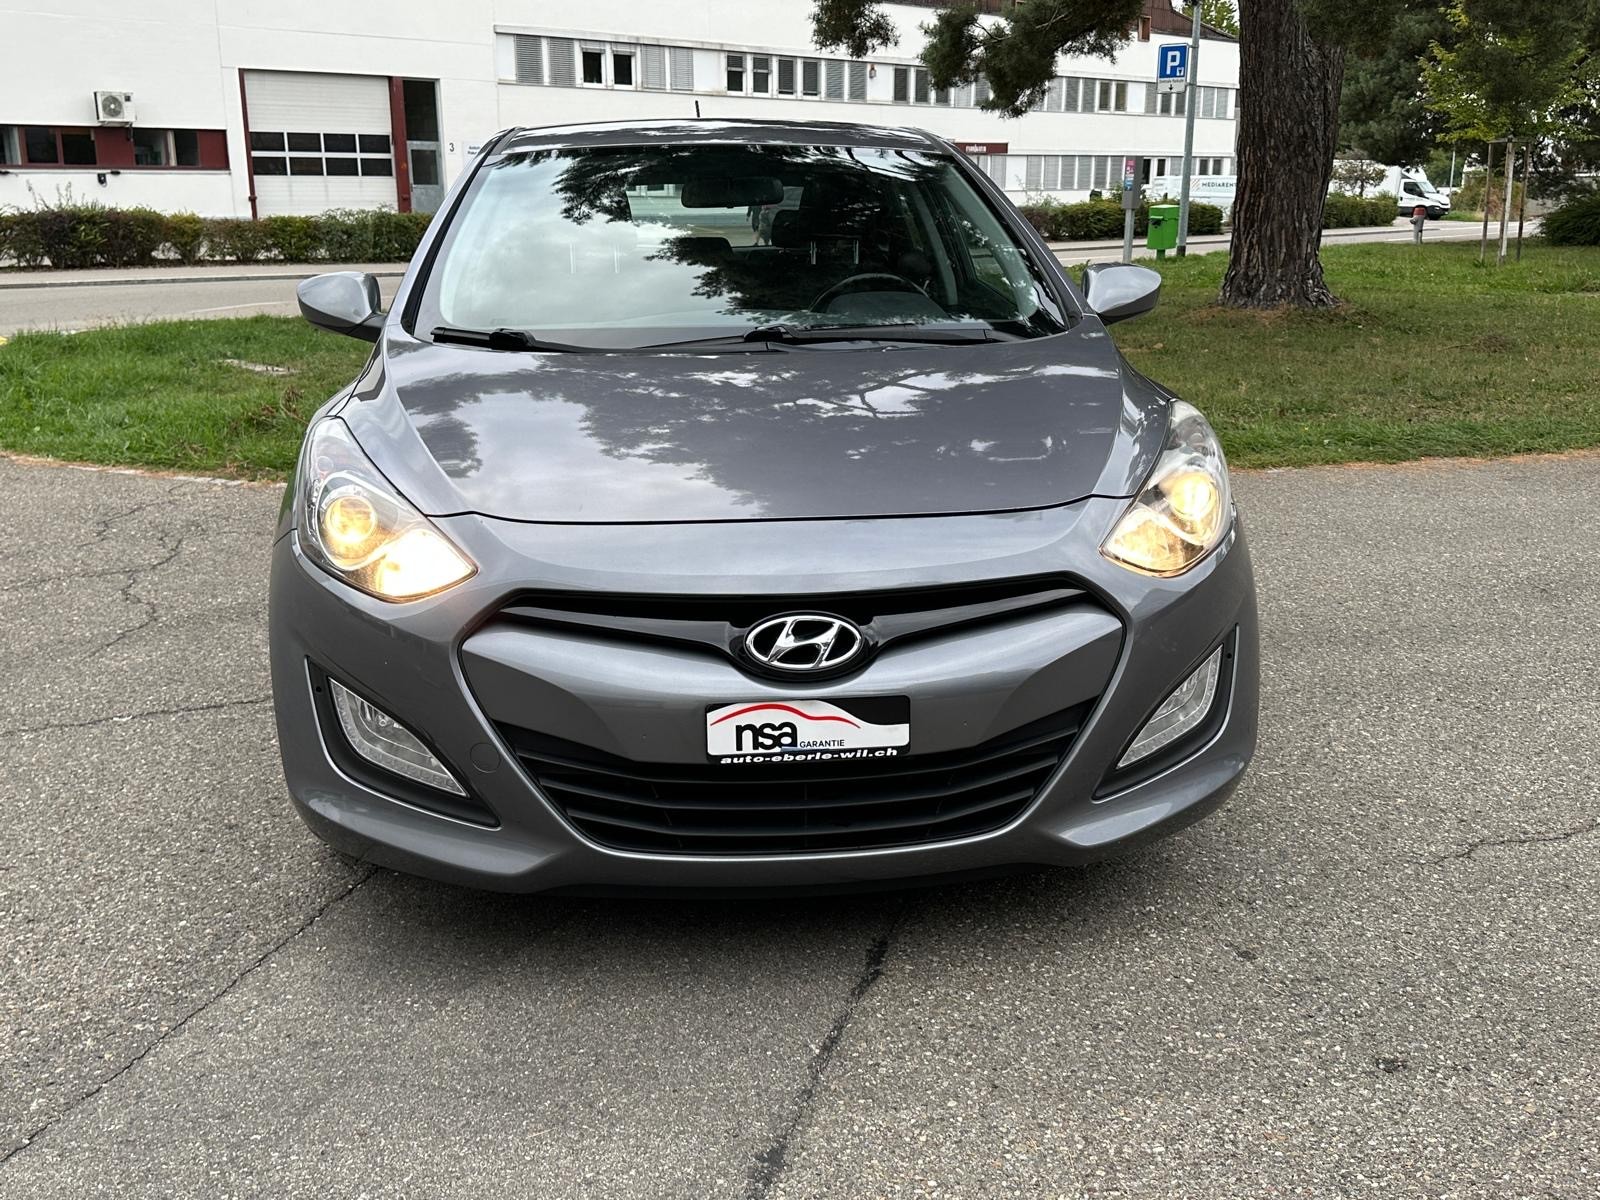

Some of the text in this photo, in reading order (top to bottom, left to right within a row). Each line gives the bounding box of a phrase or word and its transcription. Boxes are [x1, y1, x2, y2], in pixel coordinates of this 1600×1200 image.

[1166, 51, 1180, 75] P
[449, 142, 455, 153] 3
[735, 721, 845, 752] nsa GARANTIE
[720, 748, 898, 764] auto-eberle-wil.ch
